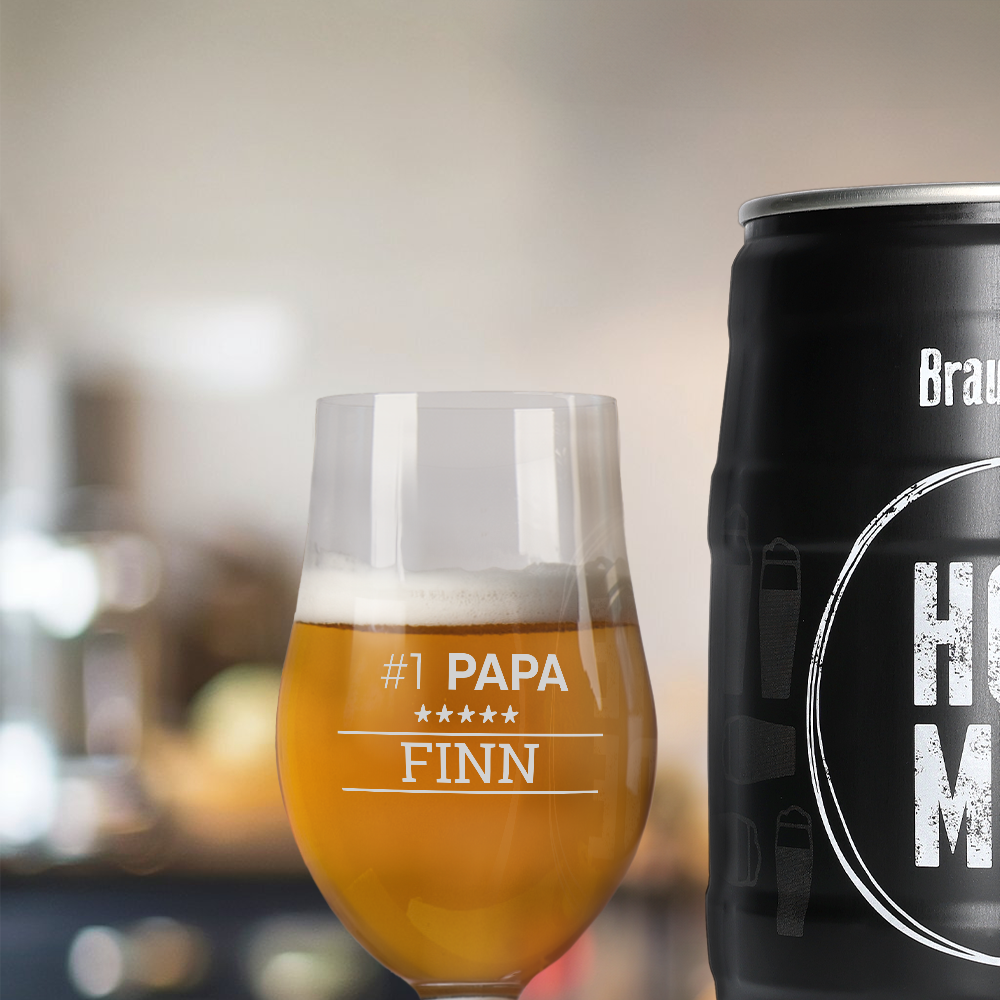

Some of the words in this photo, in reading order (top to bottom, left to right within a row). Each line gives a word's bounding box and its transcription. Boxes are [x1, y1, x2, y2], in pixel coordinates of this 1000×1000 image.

[381, 653, 422, 690] #1
[448, 652, 569, 692] PAPA
[400, 741, 540, 784] FINN
